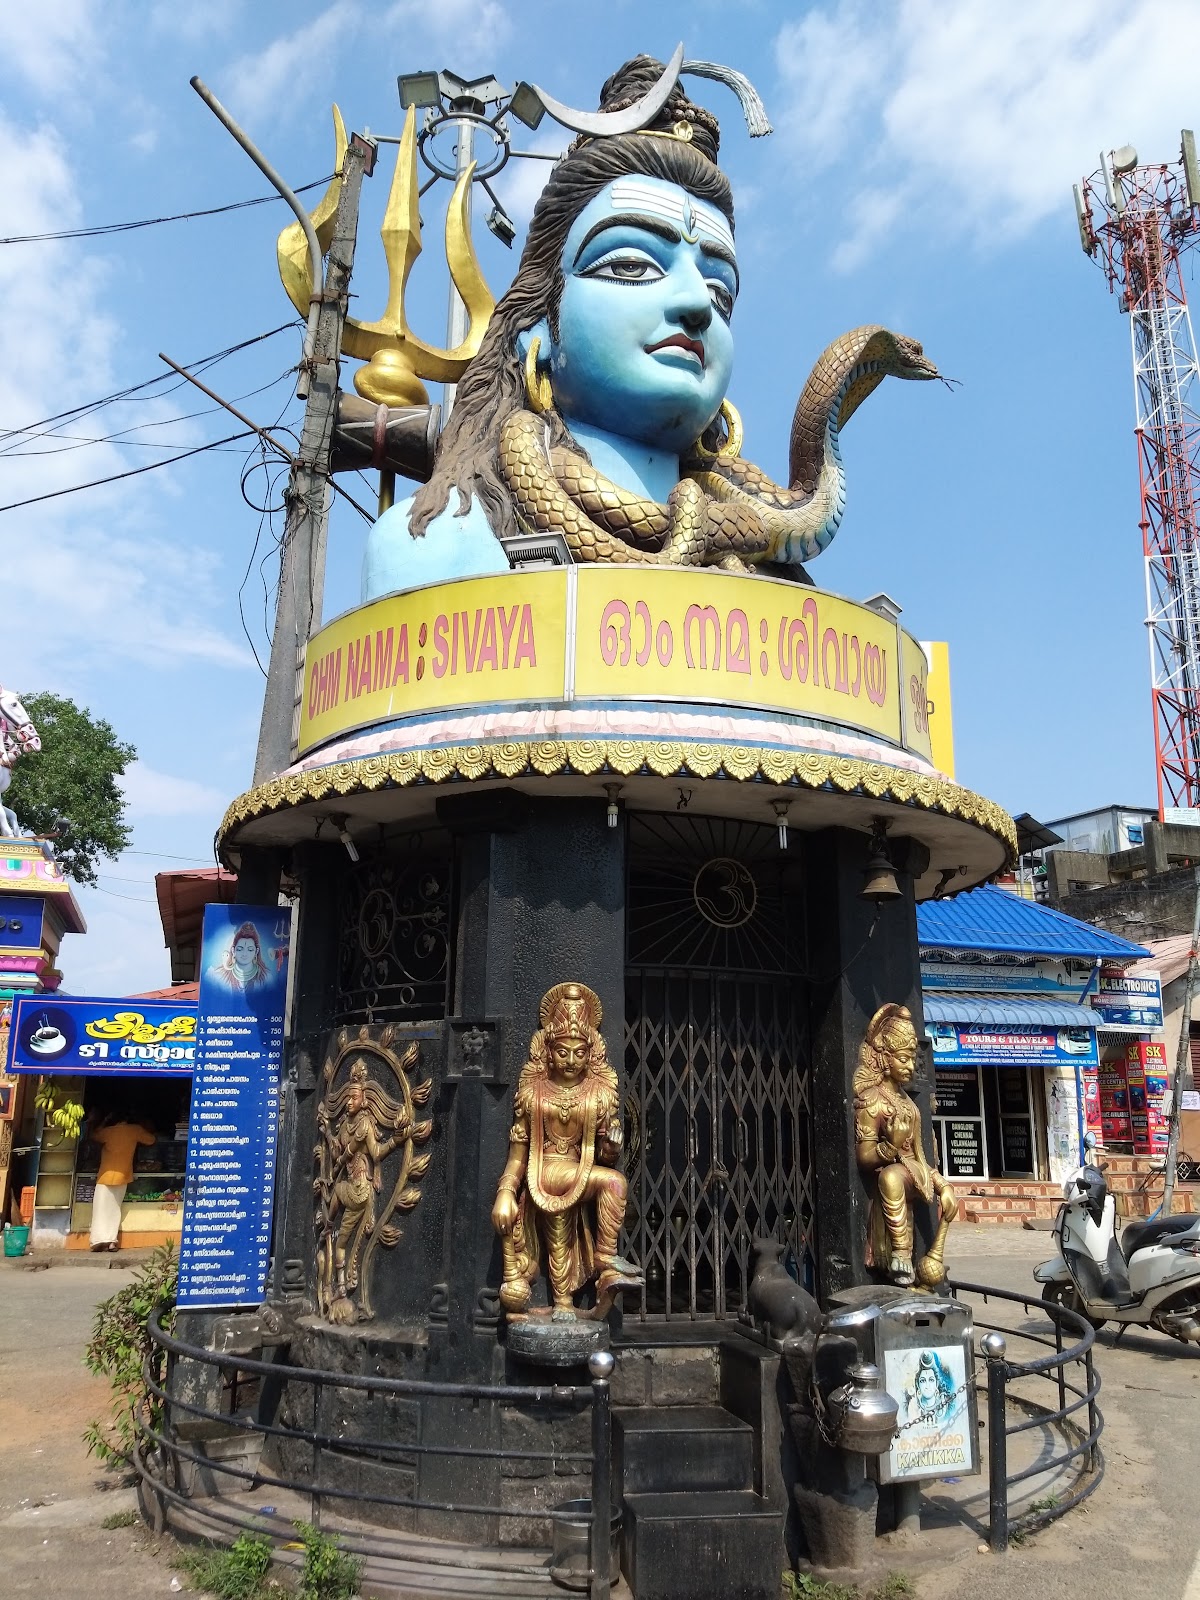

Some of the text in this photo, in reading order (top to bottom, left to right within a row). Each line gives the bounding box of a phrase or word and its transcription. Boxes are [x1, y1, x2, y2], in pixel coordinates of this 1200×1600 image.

[599, 598, 674, 668] ഓം
[308, 647, 343, 721] OHM
[431, 603, 537, 679] SIVAYA
[1111, 979, 1157, 993] ELECTRONICS
[1008, 1036, 1048, 1044] TRAVELS
[1128, 1046, 1140, 1060] SK
[1146, 1046, 1162, 1057] SK
[954, 1131, 973, 1139] CHENNAI
[896, 1448, 966, 1469] KANIKKA
